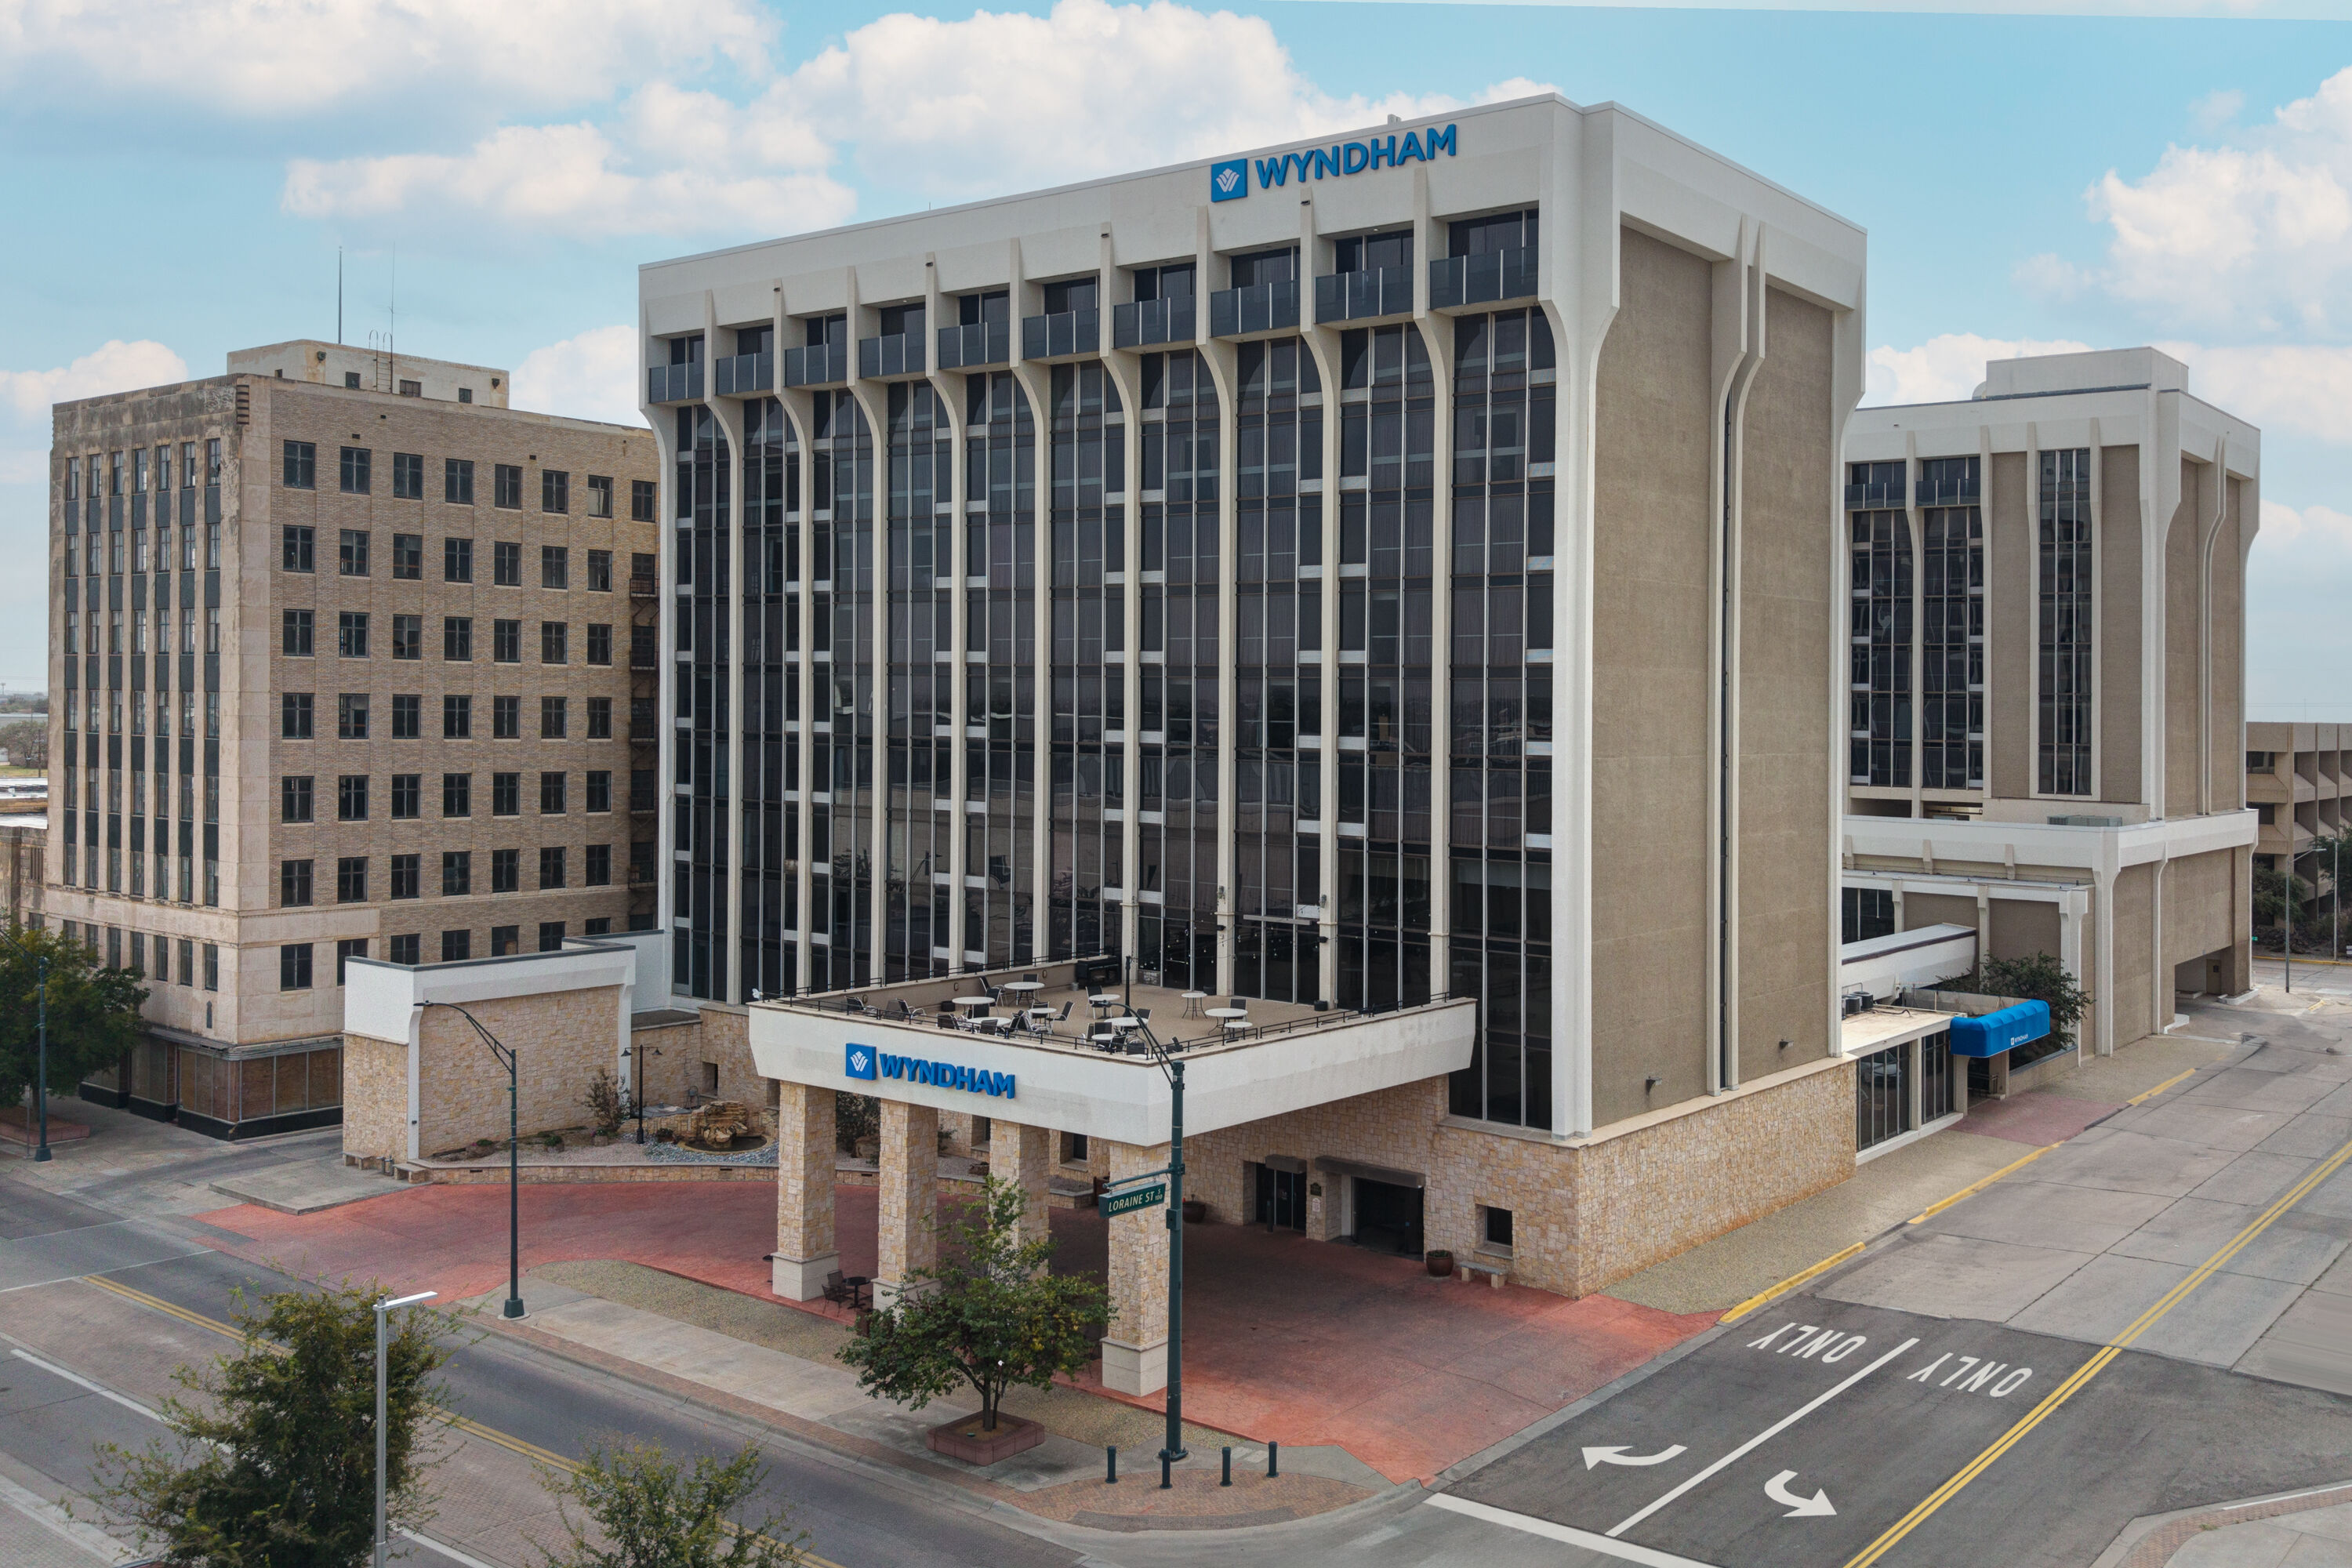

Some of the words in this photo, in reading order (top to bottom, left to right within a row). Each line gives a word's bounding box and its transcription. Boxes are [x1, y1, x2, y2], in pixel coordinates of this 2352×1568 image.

[1255, 124, 1457, 189] WYNDHAM
[879, 1053, 1015, 1099] WYNDHAM
[1108, 1193, 1144, 1212] LORAINE
[1145, 1191, 1155, 1203] ST
[1746, 1322, 1867, 1363] ONLY
[1906, 1352, 2033, 1397] ONLY
